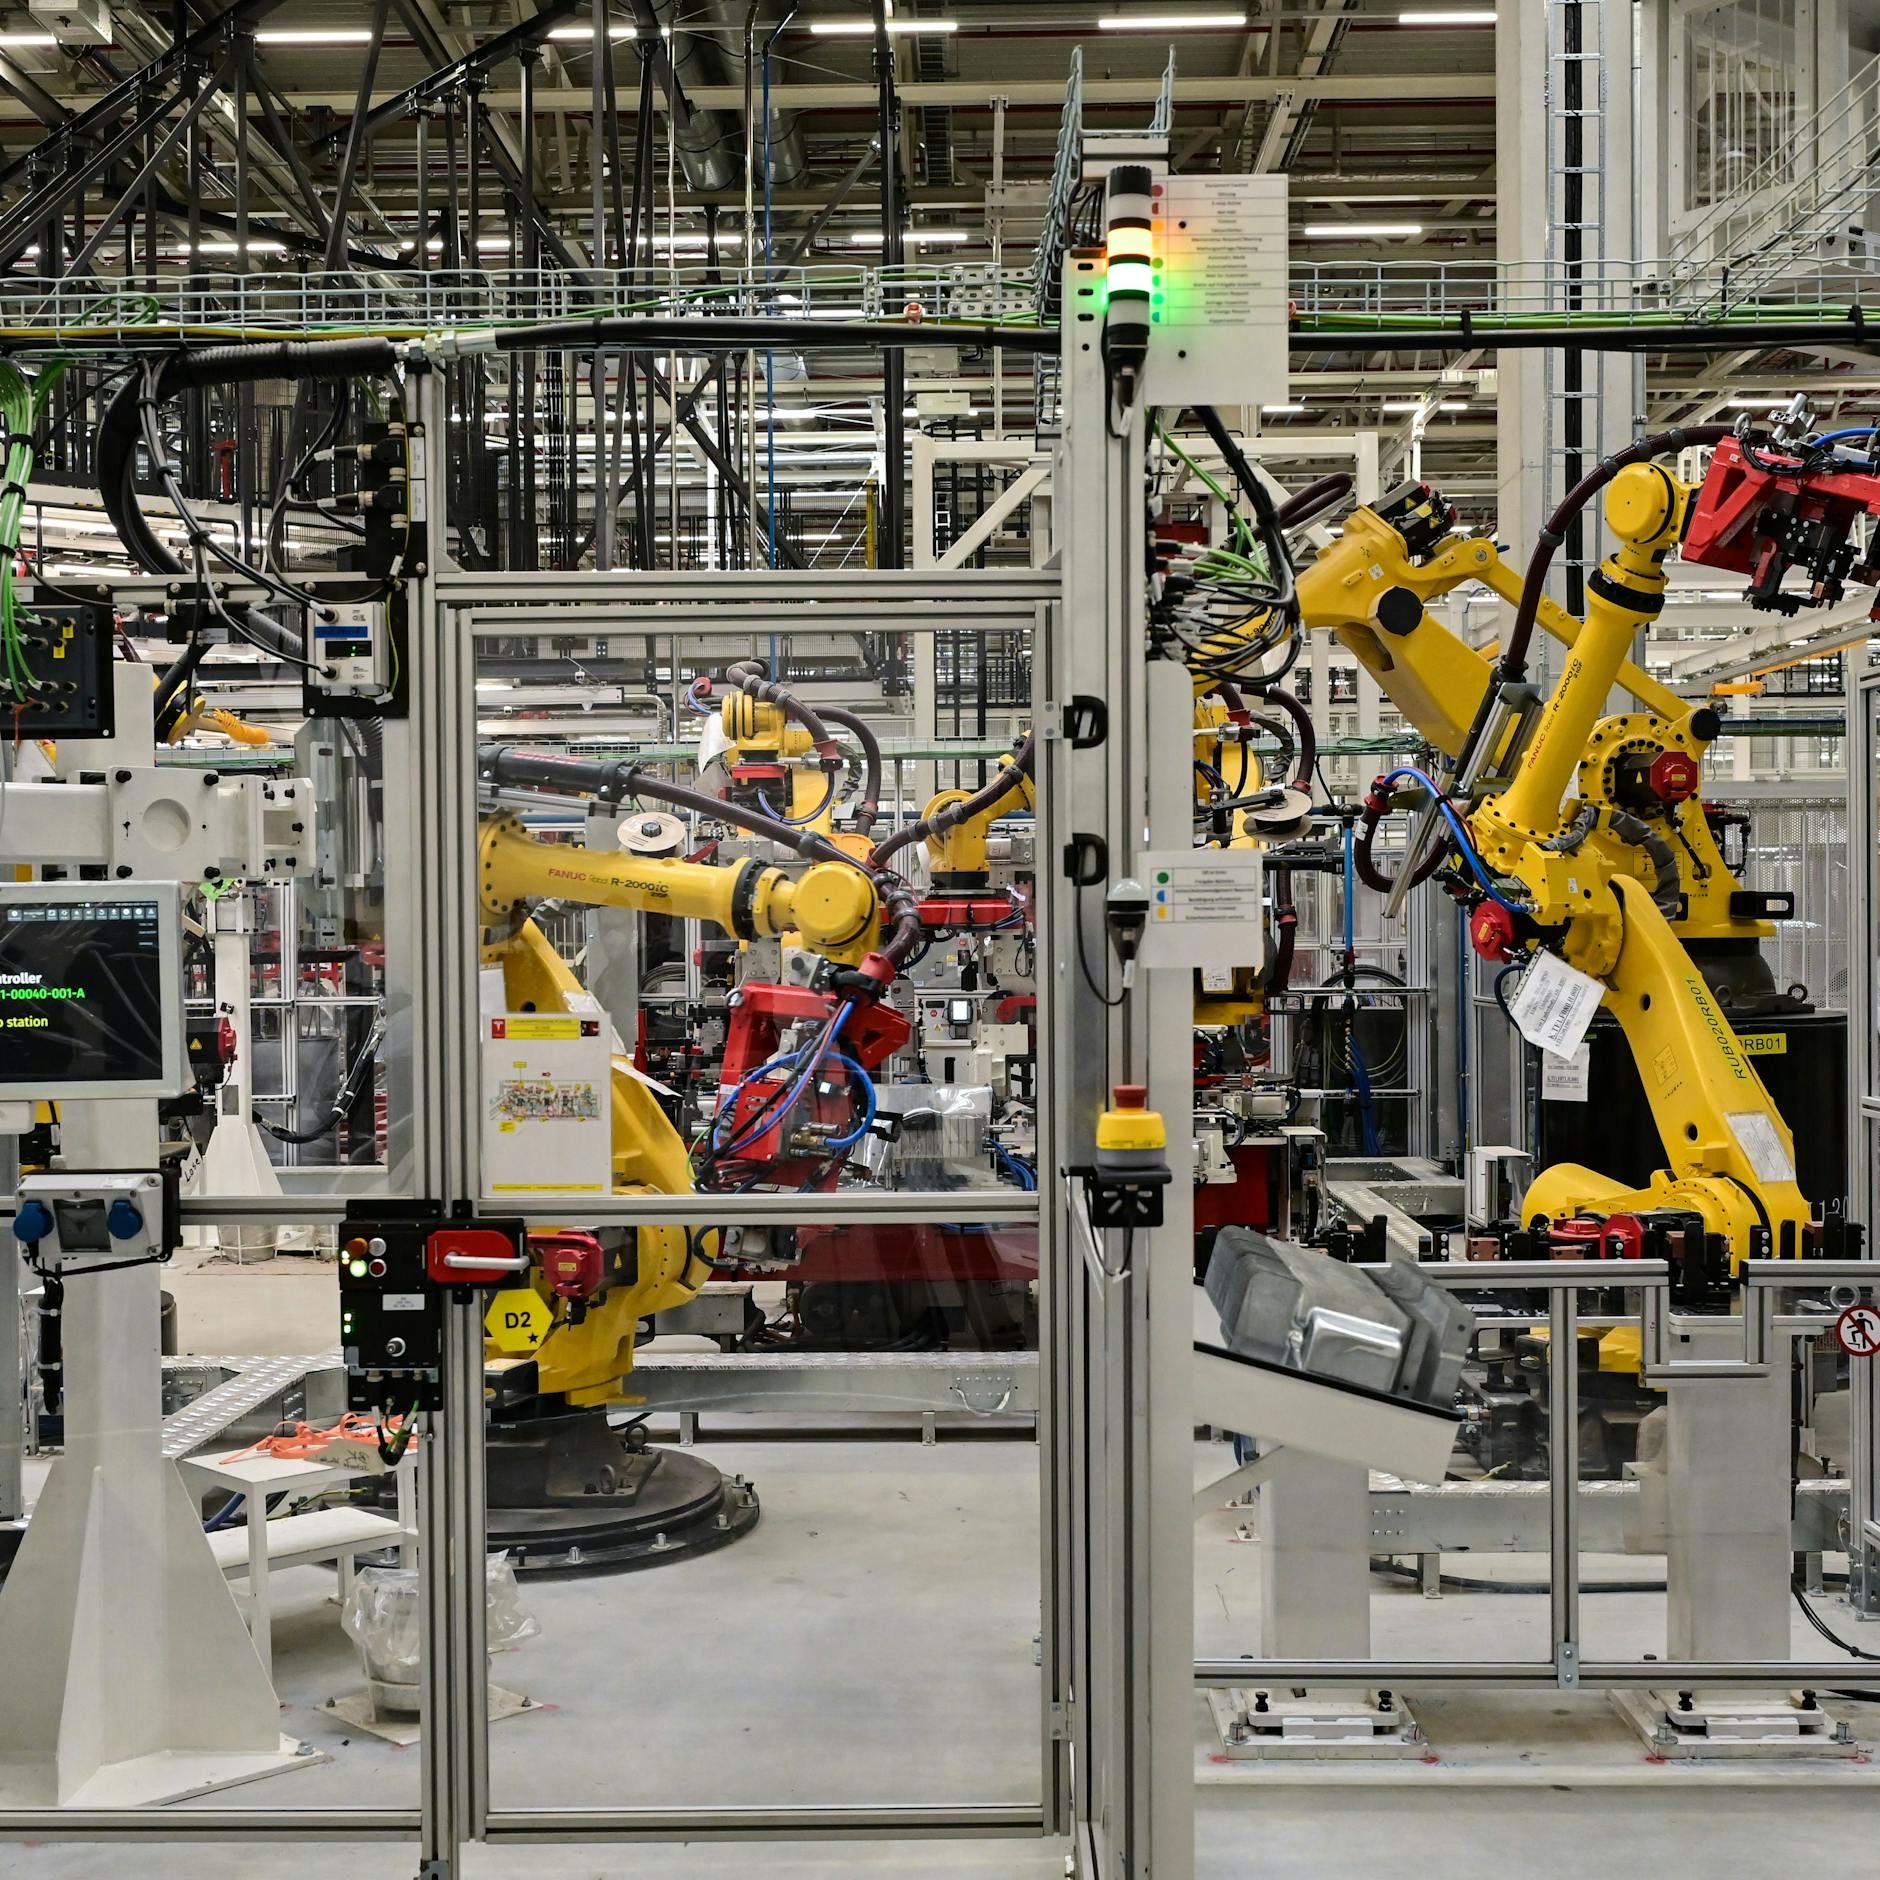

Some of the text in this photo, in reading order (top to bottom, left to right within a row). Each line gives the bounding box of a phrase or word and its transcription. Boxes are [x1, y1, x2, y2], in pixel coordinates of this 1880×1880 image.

[1528, 733, 1546, 768] FANUC
[548, 868, 587, 881] FANUC
[6, 1015, 49, 1028] station
[1686, 979, 1747, 1079] RUB020RB01
[505, 1312, 531, 1329] D2
